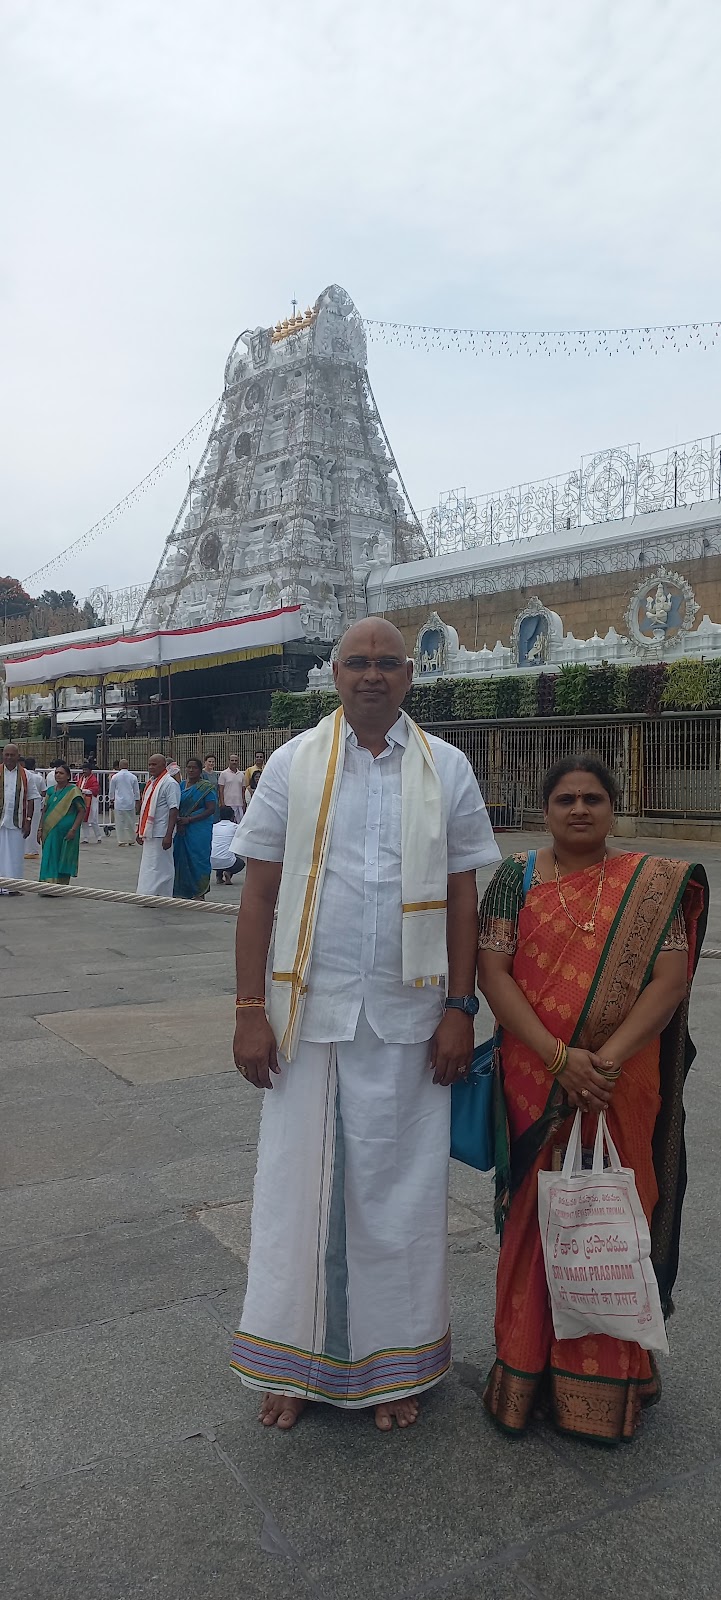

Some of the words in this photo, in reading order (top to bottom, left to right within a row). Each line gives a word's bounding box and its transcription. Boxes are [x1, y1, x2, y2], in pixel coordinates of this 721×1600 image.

[582, 1234, 628, 1260] ప్రసాదము
[552, 1264, 563, 1279] SRI
[564, 1266, 588, 1281] VAARI
[588, 1264, 634, 1281] PRASADAM
[569, 1287, 600, 1305] बालाजी
[600, 1293, 614, 1305] का
[614, 1292, 638, 1306] प्रसाद
